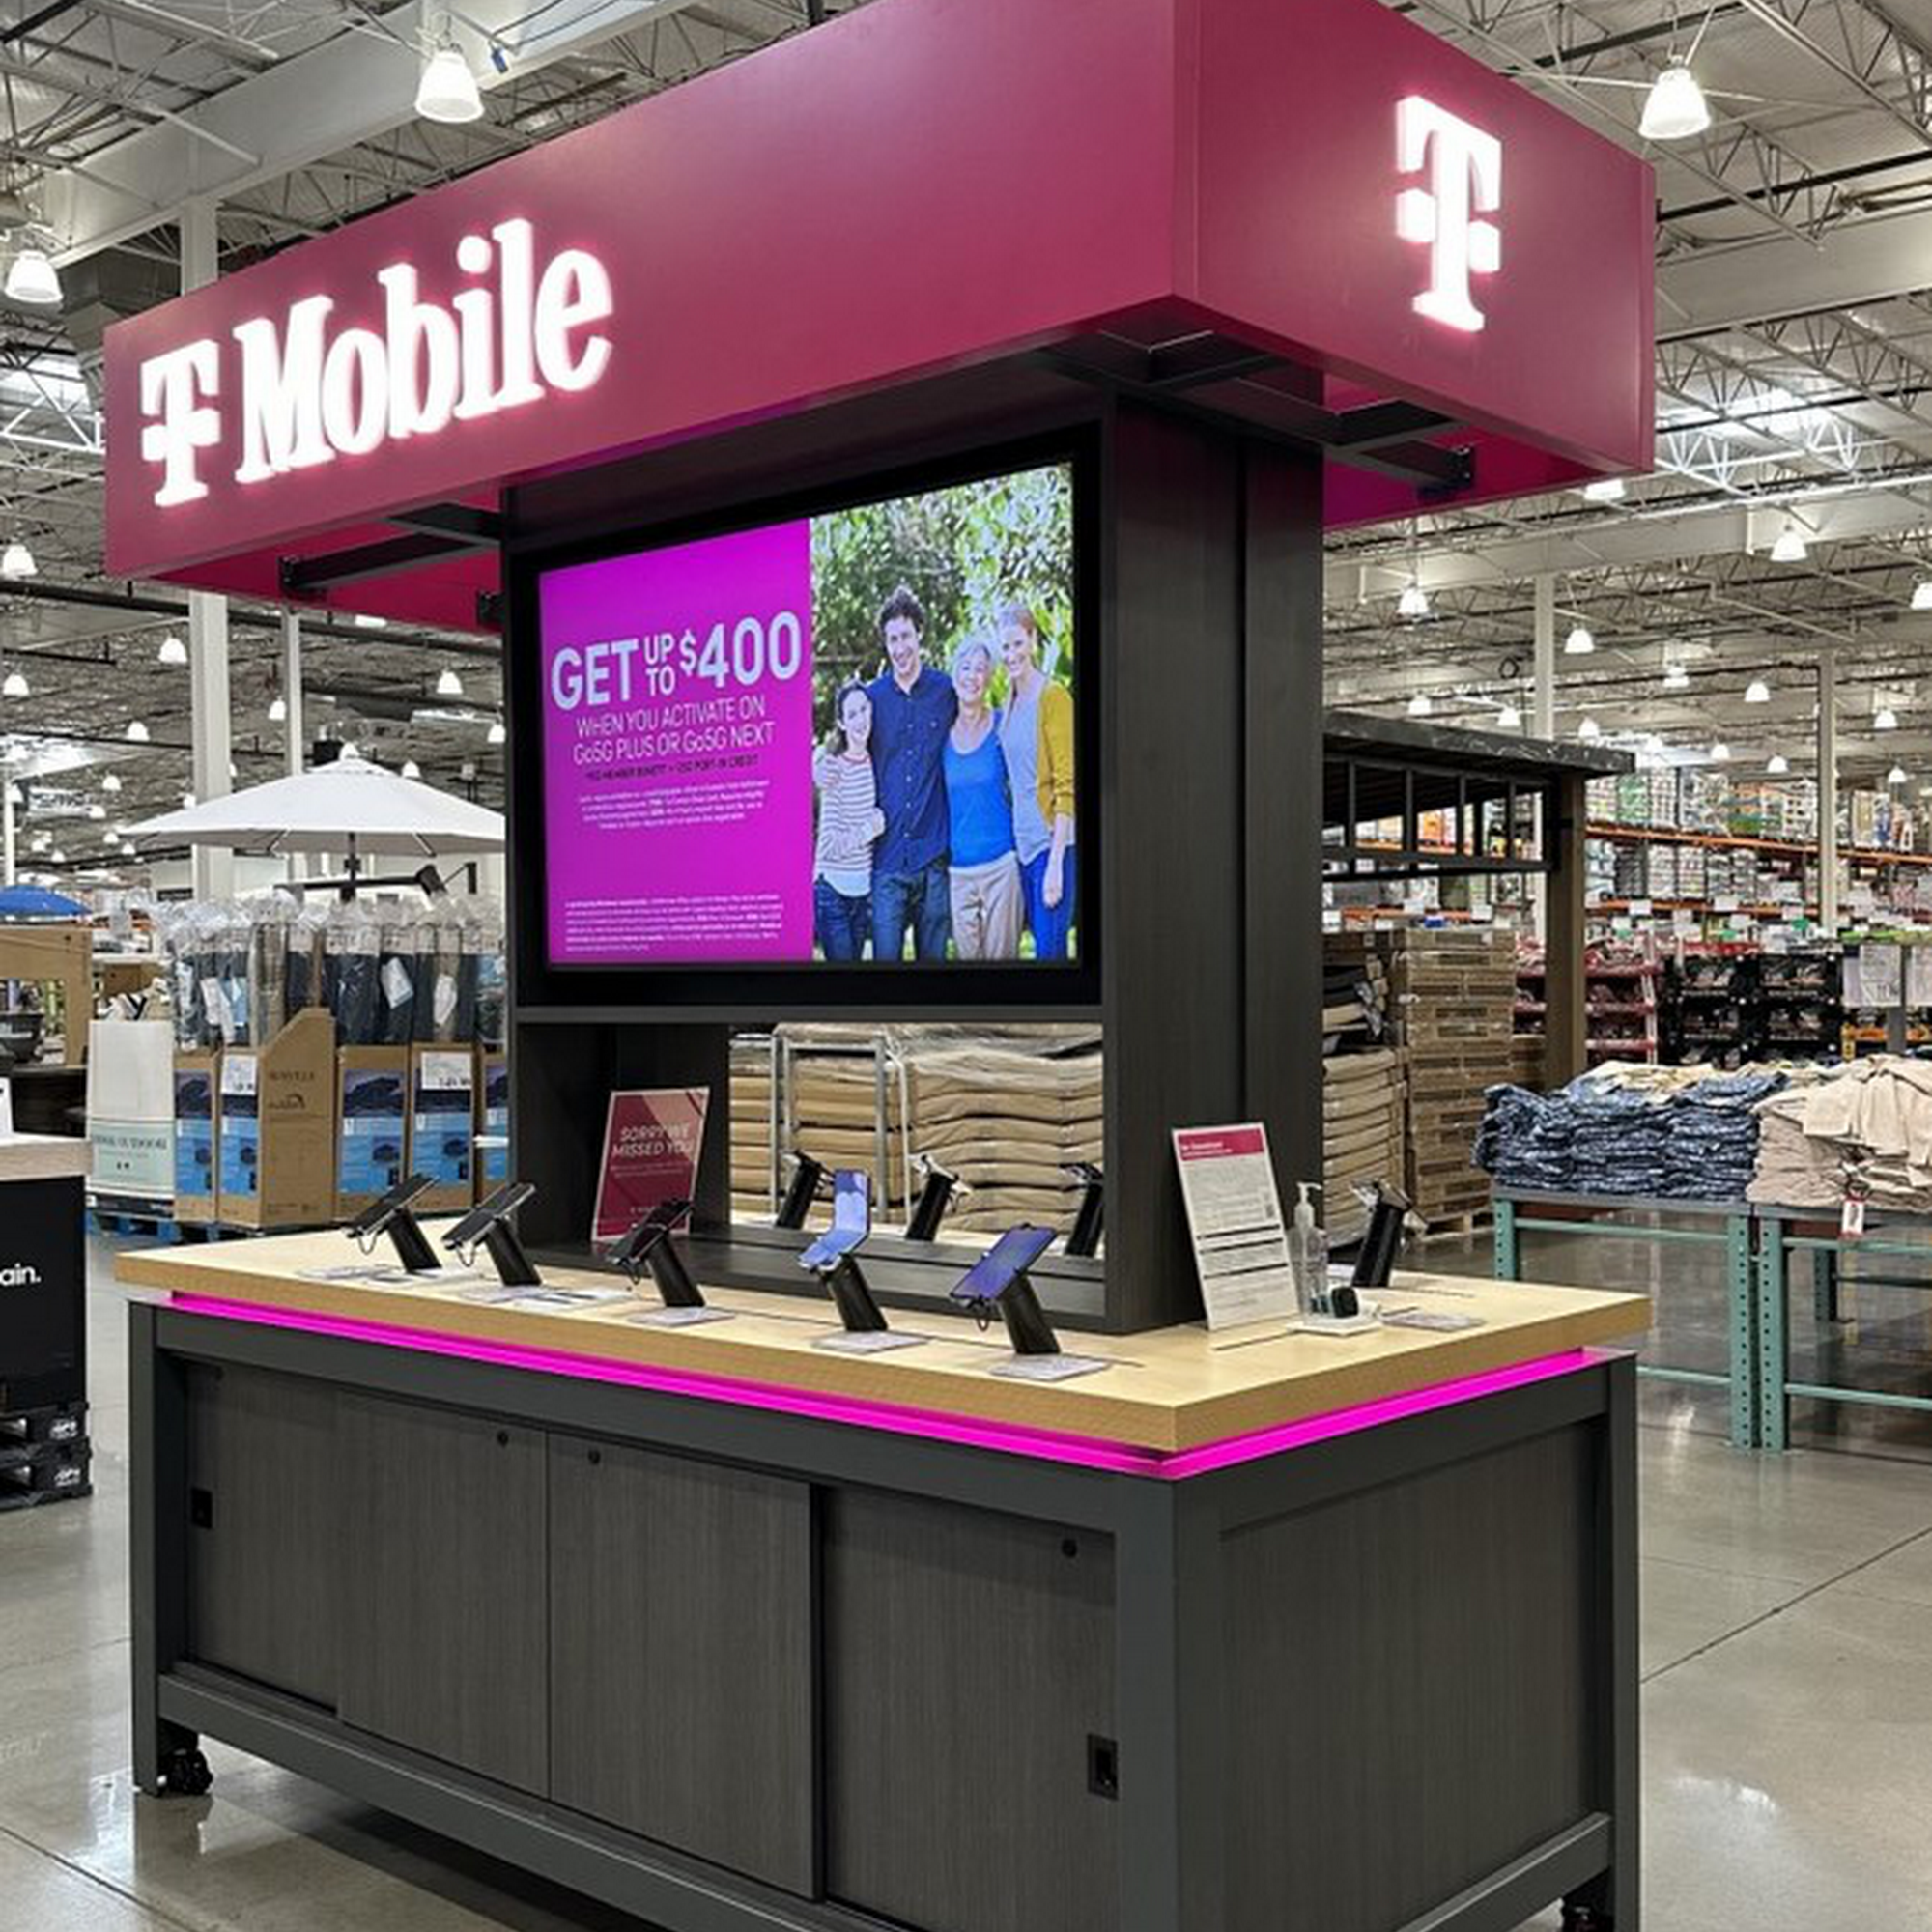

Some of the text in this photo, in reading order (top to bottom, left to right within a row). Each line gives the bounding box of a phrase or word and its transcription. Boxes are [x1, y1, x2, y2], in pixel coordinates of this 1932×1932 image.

[1396, 95, 1501, 332] T
[233, 218, 613, 483] Mobile
[552, 611, 802, 710] GET UP $400
[644, 665, 675, 696] TO
[576, 694, 766, 739] WHEN YOU ACTIVATE ON
[616, 734, 656, 759] PLUS
[657, 732, 681, 756] OR
[730, 721, 776, 747] NEXT
[611, 1138, 695, 1158] MISSED YOU
